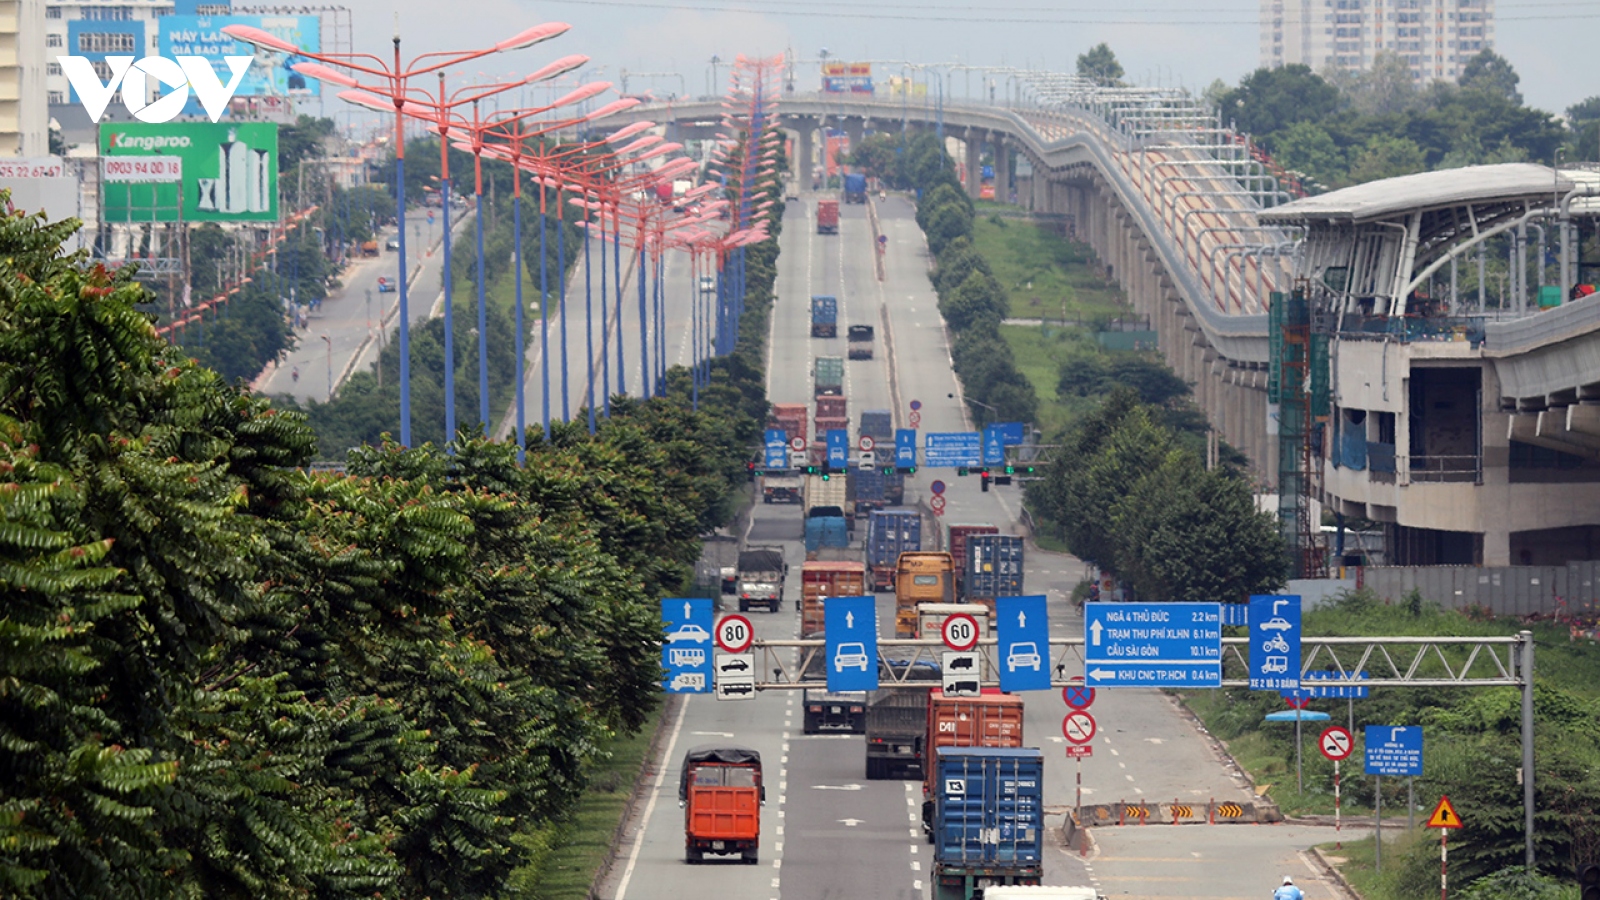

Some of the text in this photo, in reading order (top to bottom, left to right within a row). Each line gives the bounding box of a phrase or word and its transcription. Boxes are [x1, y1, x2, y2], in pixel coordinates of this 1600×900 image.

[170, 29, 197, 42] MÁY
[194, 46, 218, 55] BAO
[109, 132, 190, 150] Kangaroo
[107, 162, 132, 174] 0903
[135, 162, 147, 174] 94
[1106, 609, 1218, 622] NGÃ 4 THỦ ĐỨC 2.2 km
[725, 625, 744, 642] 80
[951, 624, 970, 640] 60
[1107, 629, 1131, 641] TRẠM
[1131, 629, 1149, 639] THU
[1150, 627, 1166, 639] PHÍ
[1166, 629, 1190, 639] XLHN
[1205, 629, 1218, 639] km
[1106, 643, 1218, 656] CẦU SÀI GÒN 10.1 km
[1118, 670, 1136, 680] KHU
[1137, 670, 1155, 680] CNC
[1191, 670, 1204, 680] 0.4
[1205, 670, 1218, 680] km
[1250, 679, 1260, 688] XE
[1260, 679, 1266, 688] 2
[1275, 679, 1281, 688] 3
